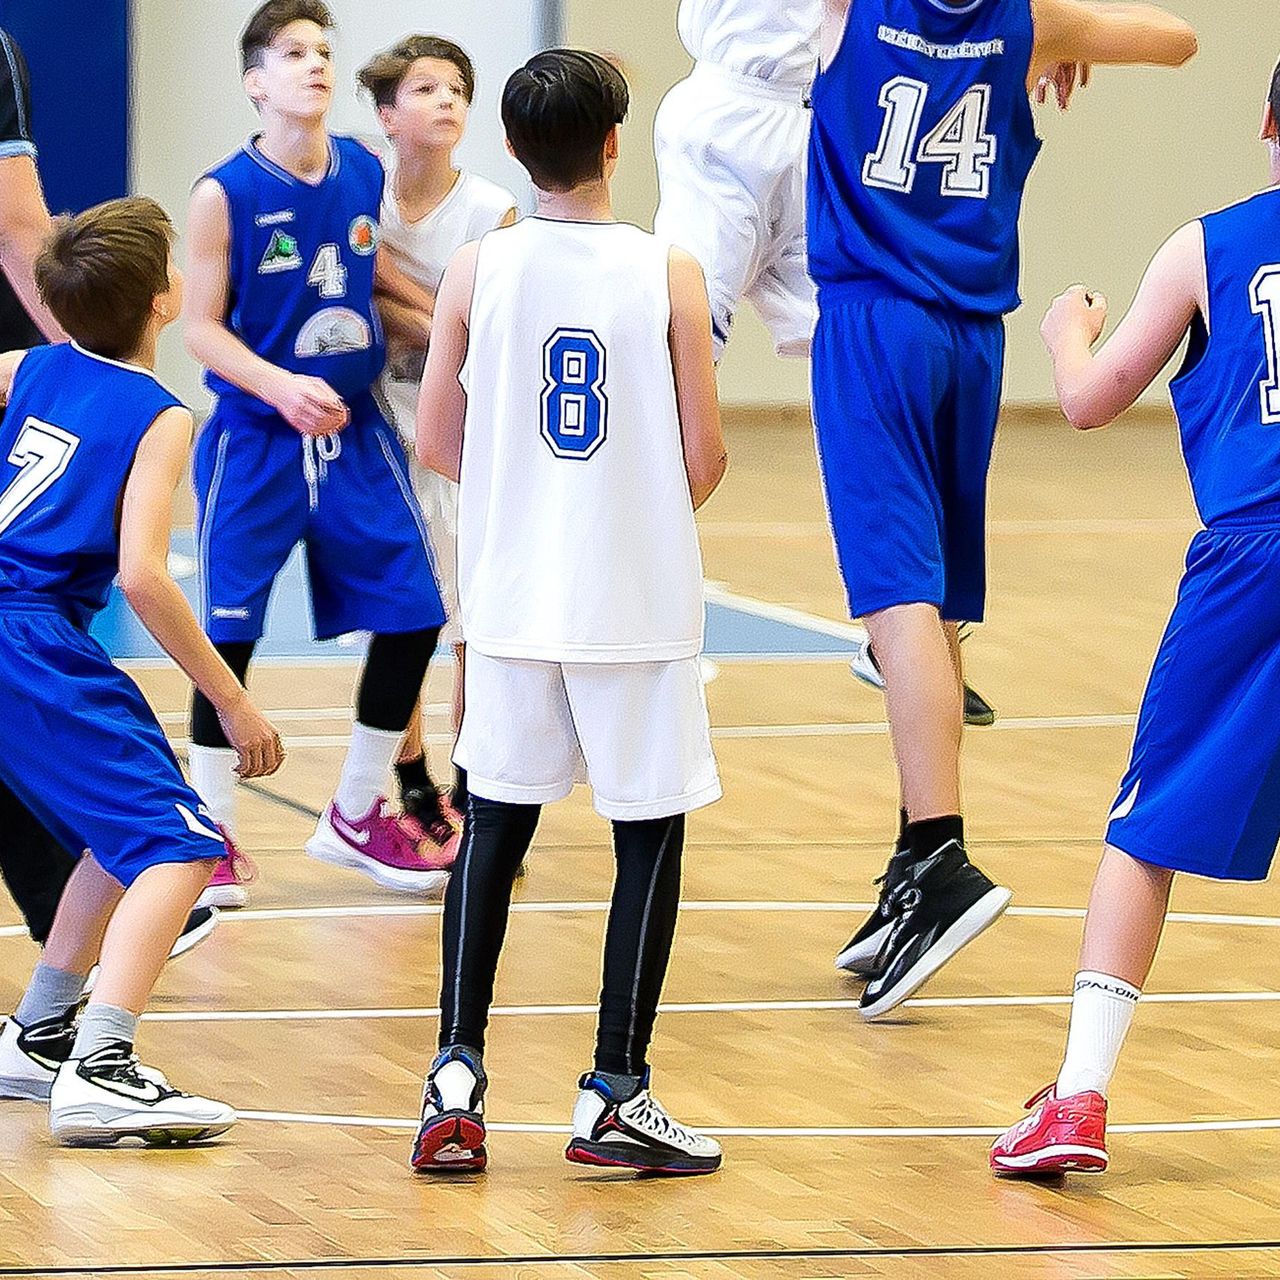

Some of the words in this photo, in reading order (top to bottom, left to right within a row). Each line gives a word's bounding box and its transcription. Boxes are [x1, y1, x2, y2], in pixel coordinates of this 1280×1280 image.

[862, 75, 997, 199] 14
[307, 243, 348, 299] 4
[540, 327, 608, 461] 8
